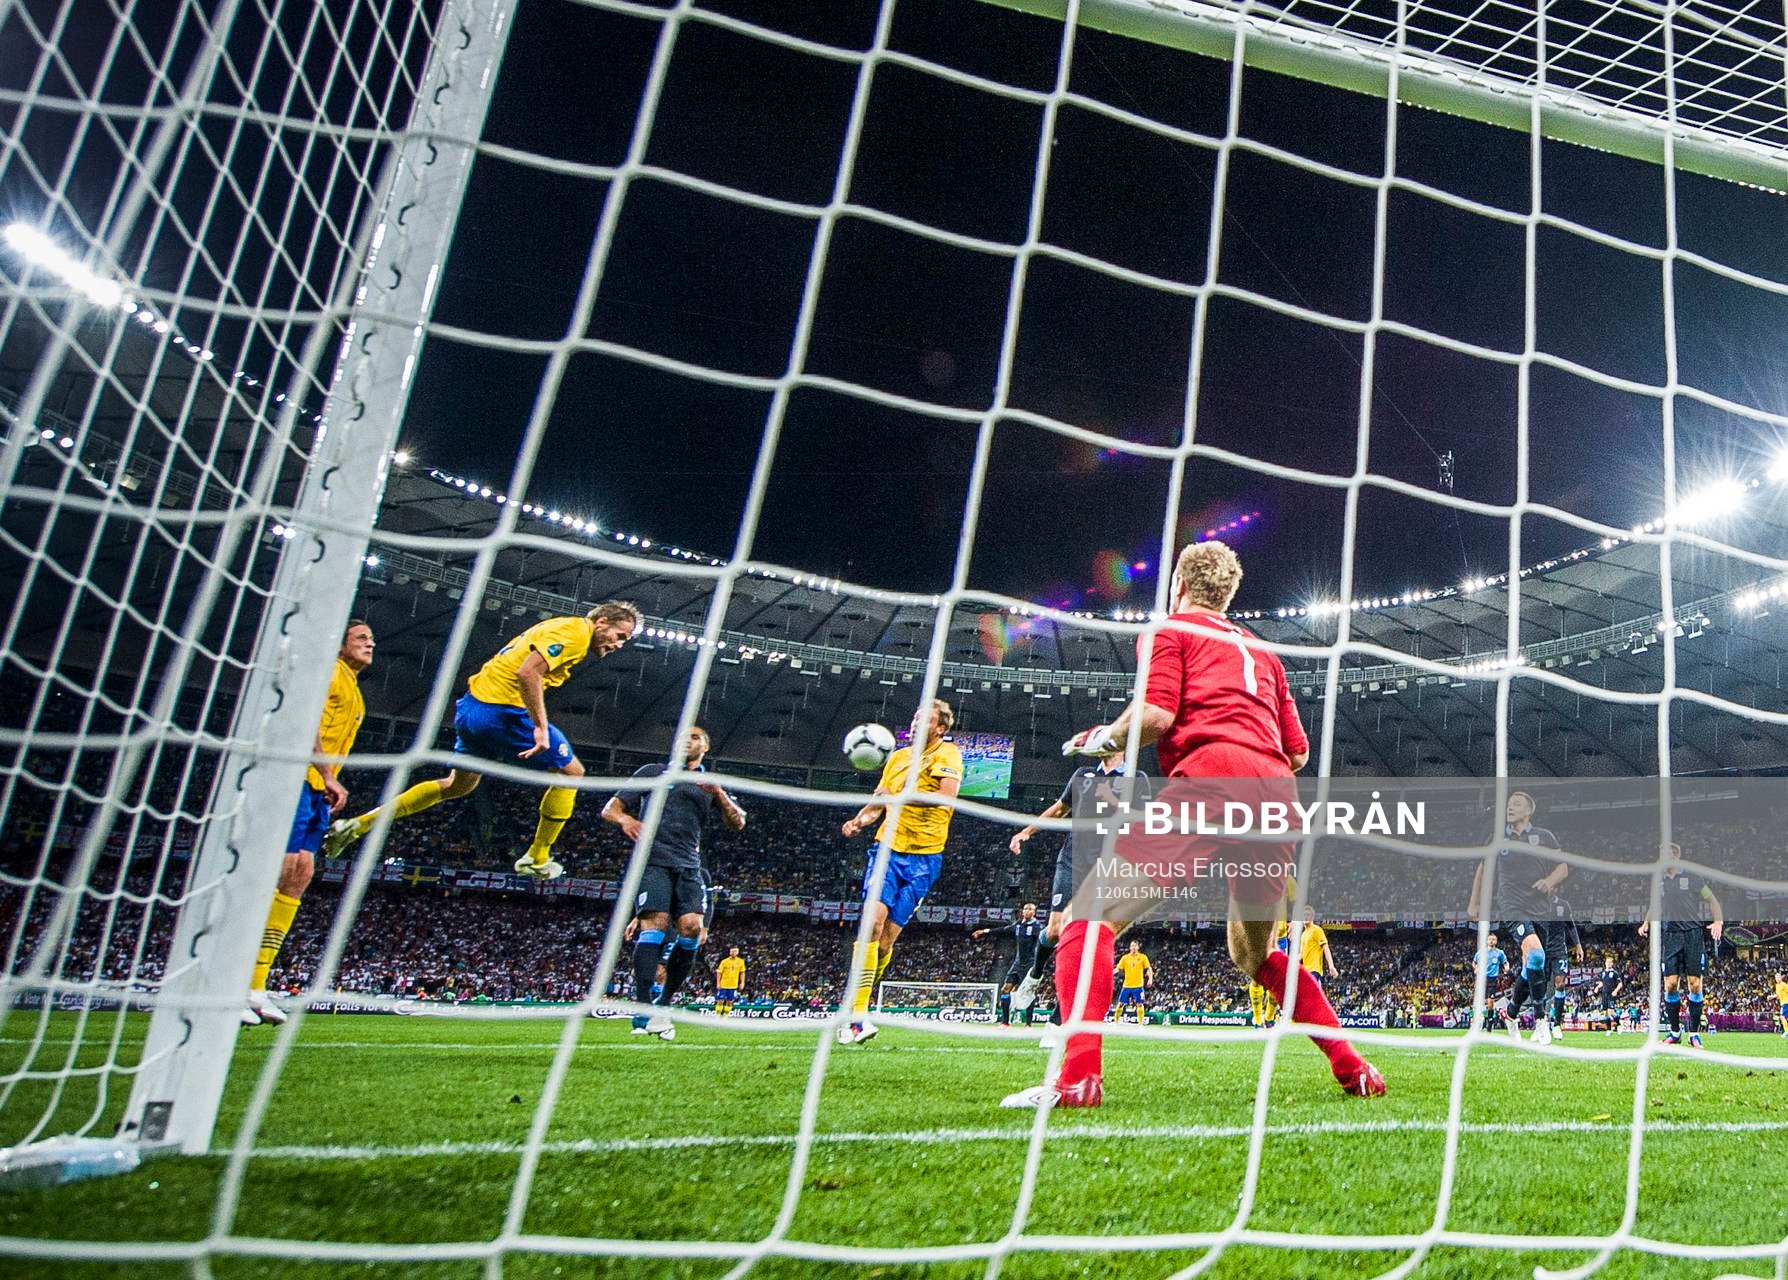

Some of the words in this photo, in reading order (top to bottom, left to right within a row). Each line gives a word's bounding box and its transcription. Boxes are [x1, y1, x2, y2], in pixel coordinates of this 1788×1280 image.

[1082, 778, 1093, 795] 9
[748, 1009, 760, 1019] for
[772, 1007, 836, 1021] Carlsberg
[1179, 1014, 1200, 1024] Drink
[1202, 1015, 1247, 1026] Responsibly
